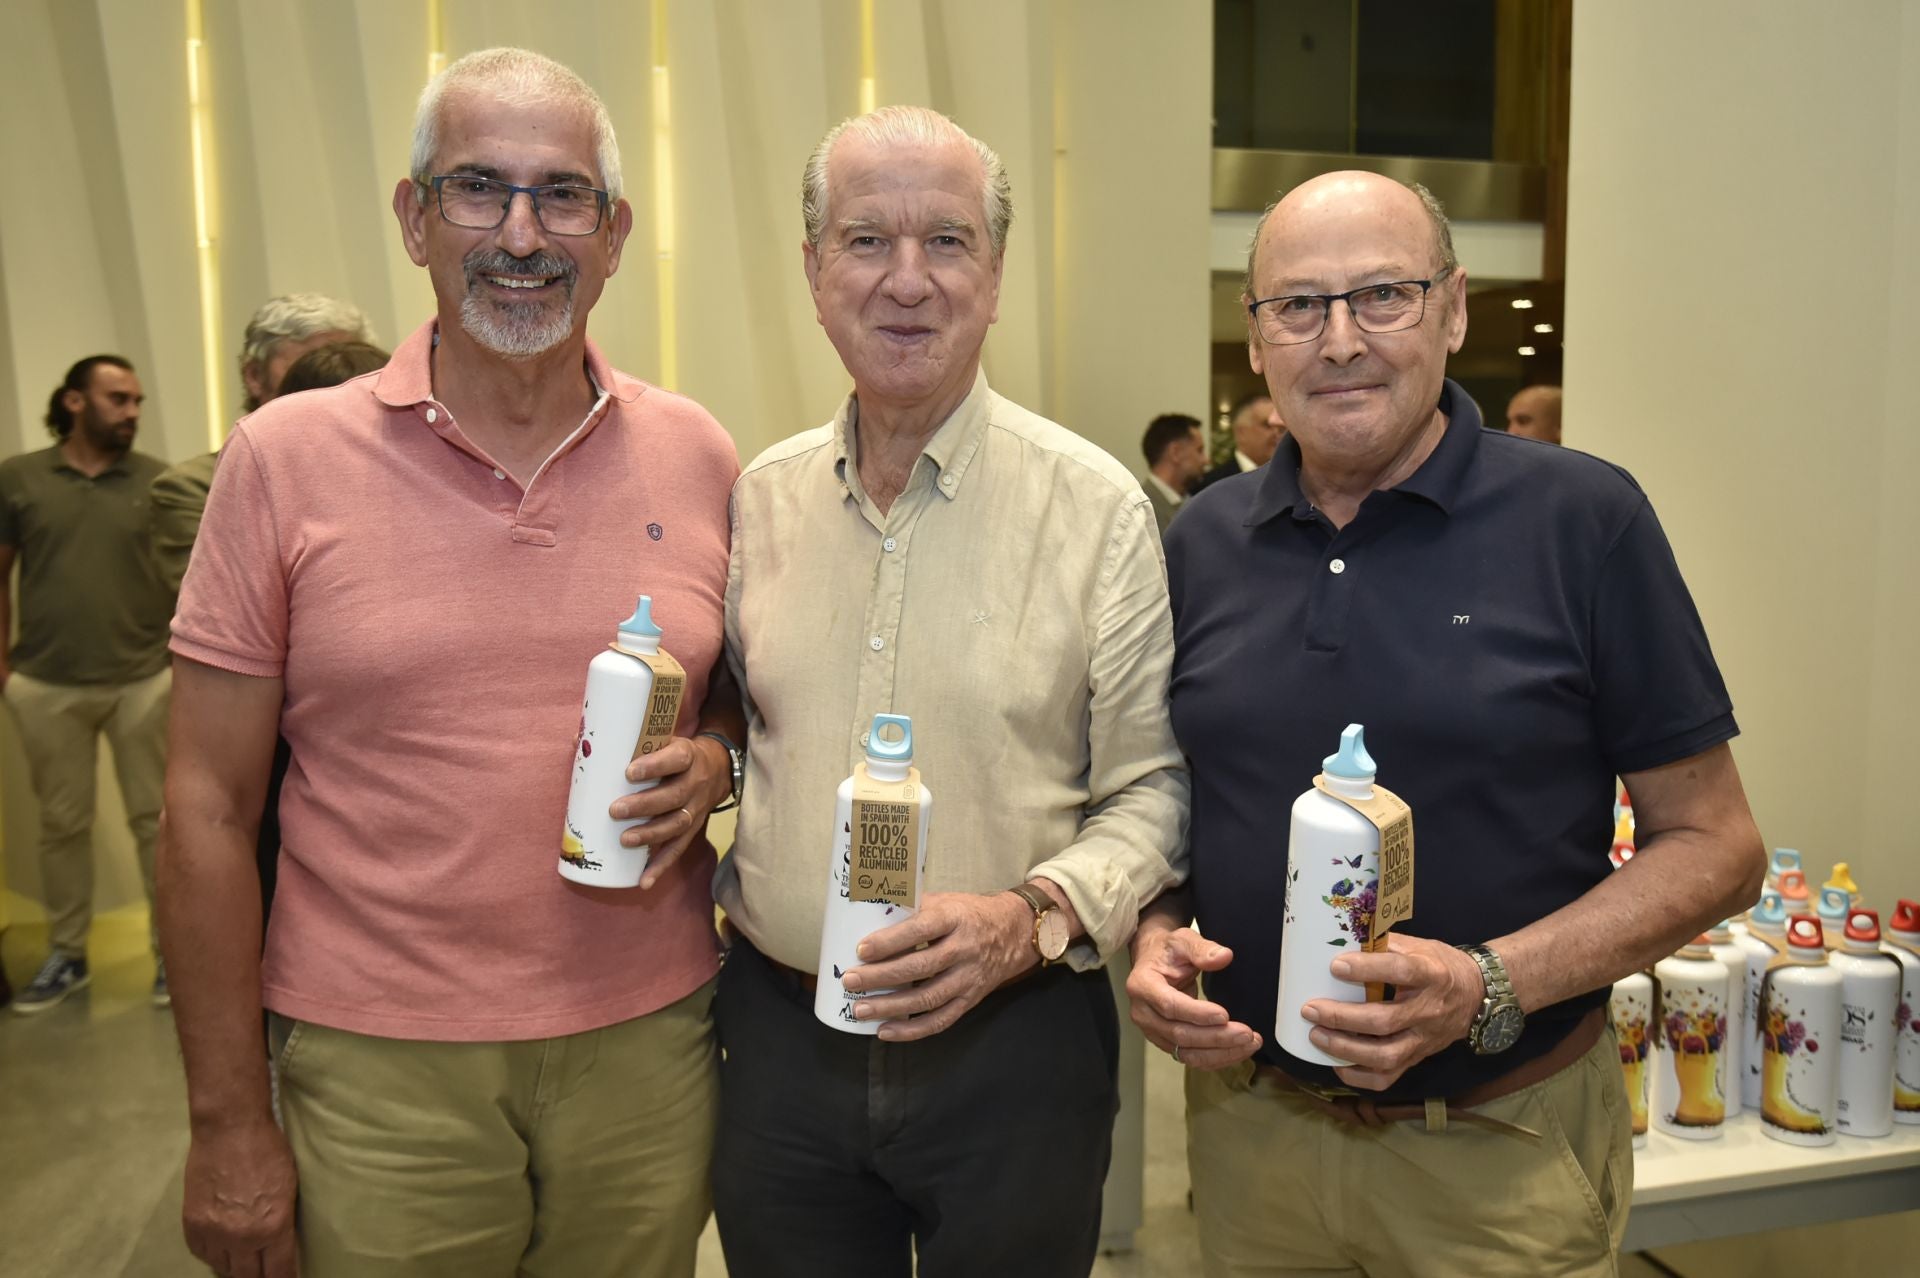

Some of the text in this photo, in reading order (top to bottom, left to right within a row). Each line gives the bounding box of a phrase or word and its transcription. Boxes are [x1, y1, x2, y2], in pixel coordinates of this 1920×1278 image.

[660, 685, 671, 693] SPAIN
[652, 694, 678, 714] 100%
[649, 714, 675, 726] RECYCLED
[646, 726, 673, 736] ALUMINIUM
[861, 803, 910, 814] BOTTLES MADE
[860, 813, 910, 824] IN SPAIN WITH
[860, 823, 908, 847] 100%
[859, 845, 908, 860] RECYCLED
[1384, 838, 1409, 872] 100%
[858, 859, 908, 872] ALUMINIUM
[1383, 861, 1410, 886] RECYCLED
[882, 889, 907, 897] LAKEN
[1383, 877, 1410, 899] ALUMINIUM
